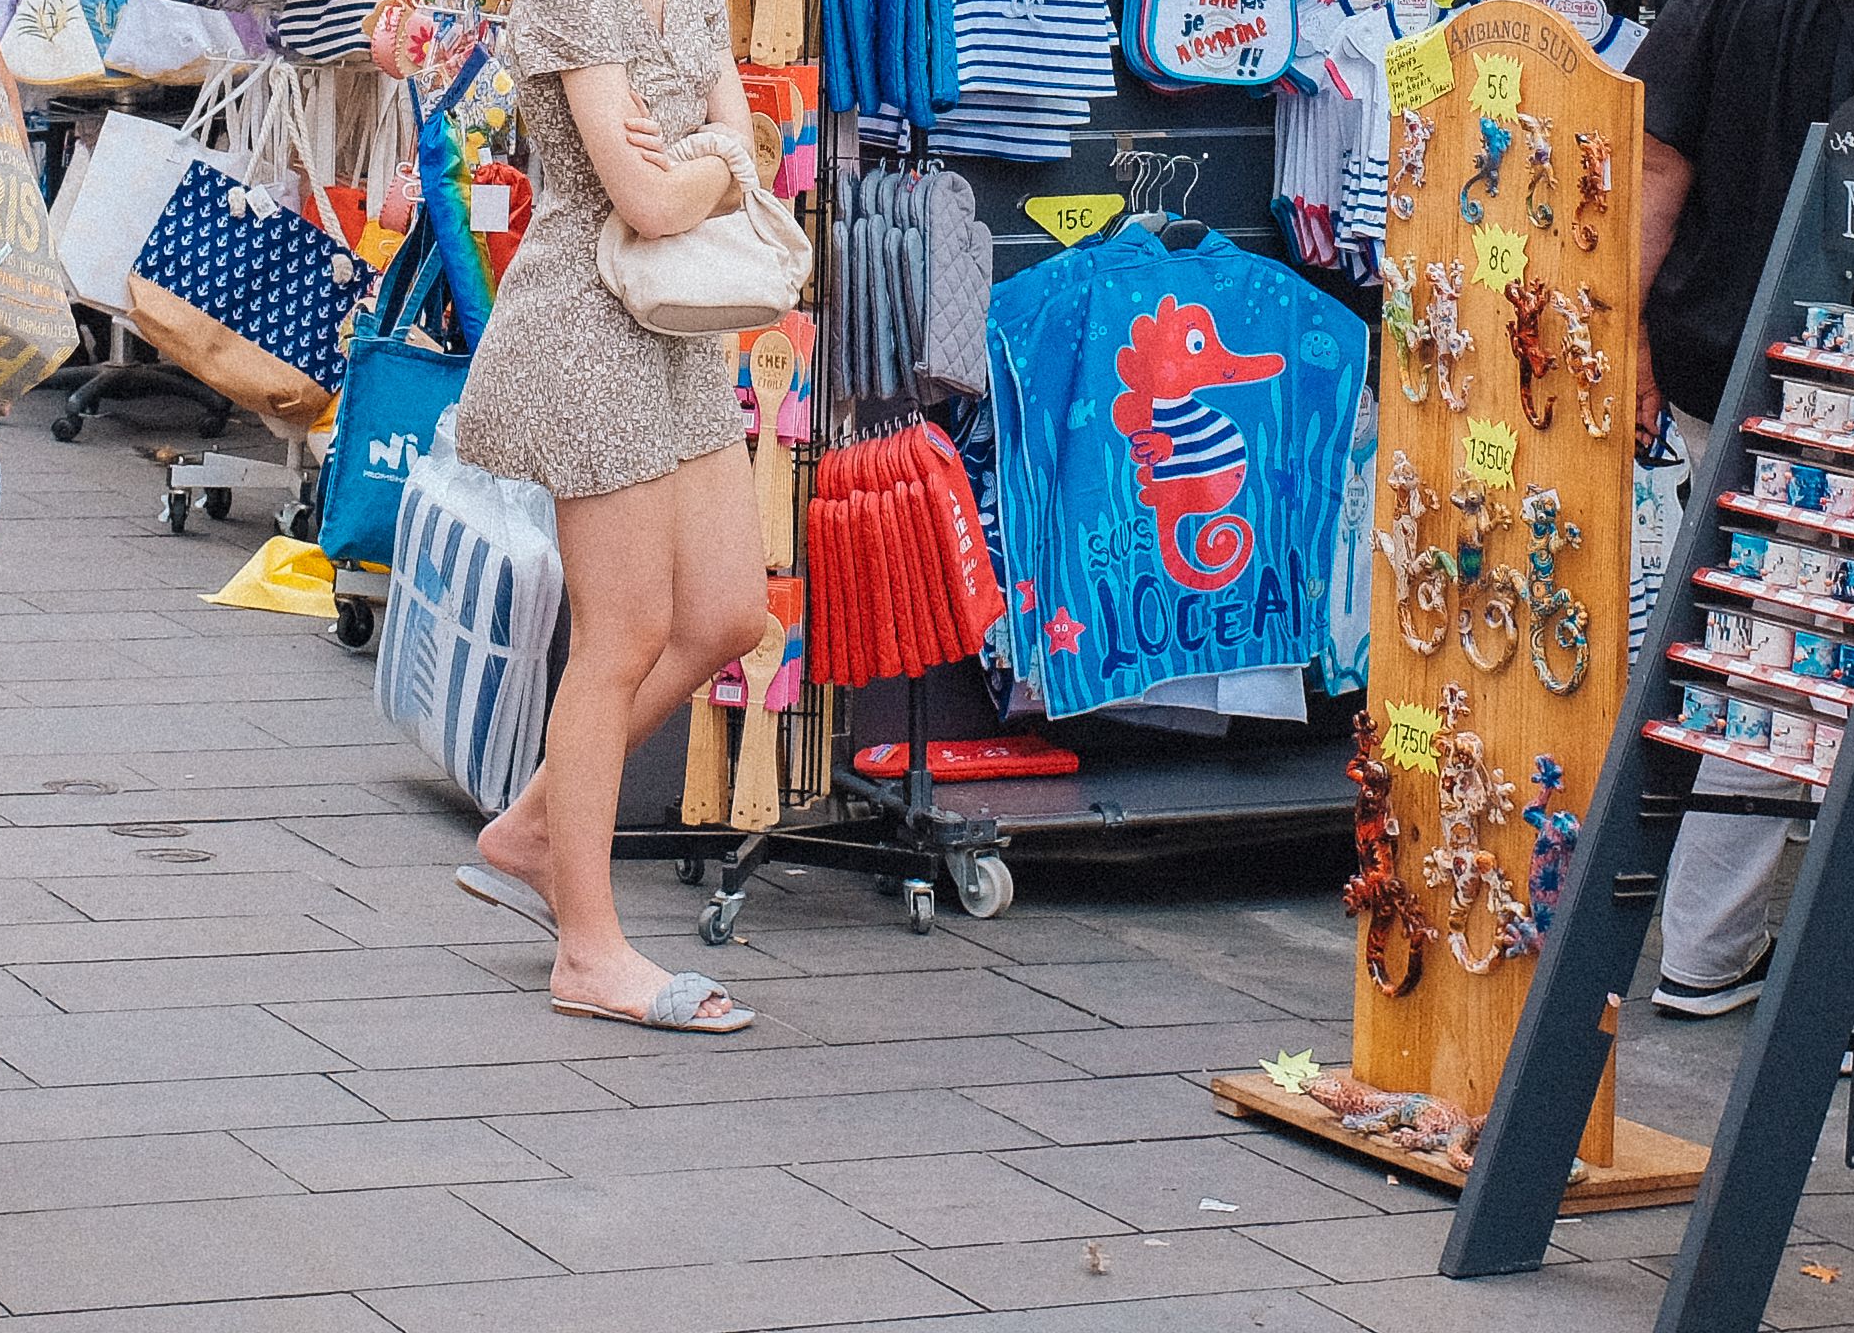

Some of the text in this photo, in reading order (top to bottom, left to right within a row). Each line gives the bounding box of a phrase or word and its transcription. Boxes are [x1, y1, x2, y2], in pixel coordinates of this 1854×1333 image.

[1180, 12, 1205, 38] je
[1447, 20, 1578, 74] AMBIANCE SUD
[1487, 74, 1509, 100] 5€
[1057, 208, 1094, 231] 15€
[1487, 245, 1512, 276] 8€
[757, 354, 788, 370] CHEF
[1467, 436, 1513, 476] 13,50€
